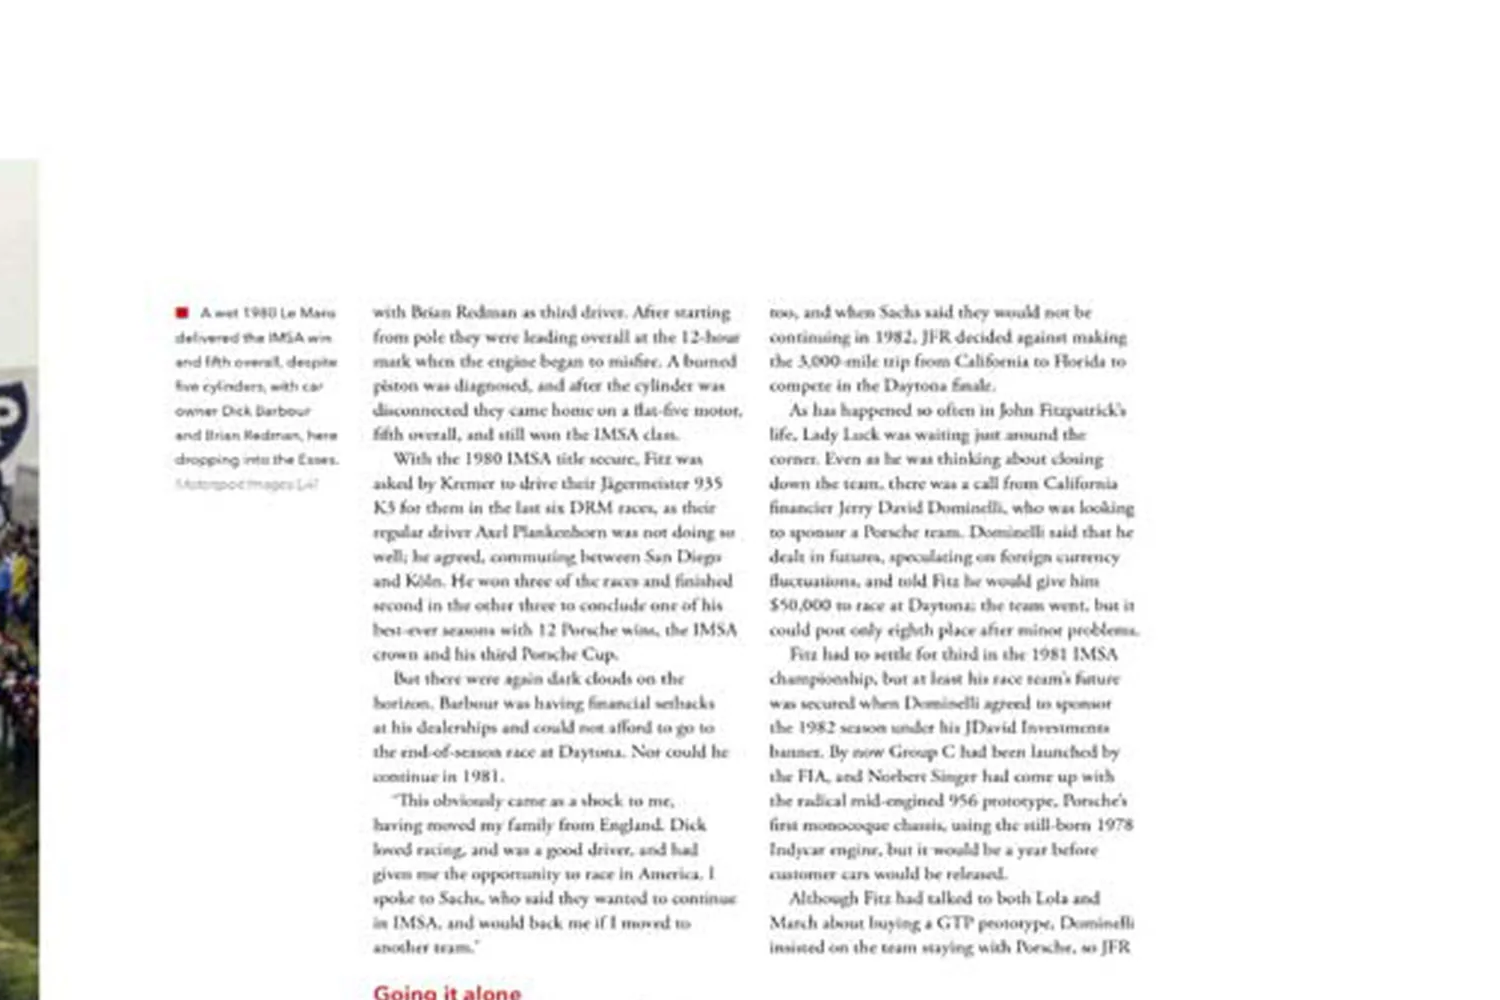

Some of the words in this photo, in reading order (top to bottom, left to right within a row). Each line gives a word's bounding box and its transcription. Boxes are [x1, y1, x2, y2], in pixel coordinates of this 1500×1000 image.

[373, 304, 406, 318] with
[411, 304, 451, 319] Brian
[456, 304, 517, 319] Redman
[522, 309, 536, 319] as
[540, 304, 577, 319] third
[581, 305, 626, 319] driver.
[632, 304, 669, 319] After
[674, 306, 731, 324] starting
[769, 476, 810, 491] down
[816, 476, 839, 490] the
[843, 480, 884, 490] team,
[888, 476, 926, 490] there
[930, 480, 957, 490] was
[962, 481, 969, 490] a
[973, 476, 999, 490] call
[1003, 475, 1039, 490] from
[1043, 476, 1118, 490] California
[770, 720, 793, 734] the
[800, 721, 836, 734] 1982
[840, 724, 887, 734] season
[891, 720, 934, 734] under
[940, 720, 960, 734] his
[965, 719, 1017, 736] JDavid
[1022, 720, 1110, 734] Investments
